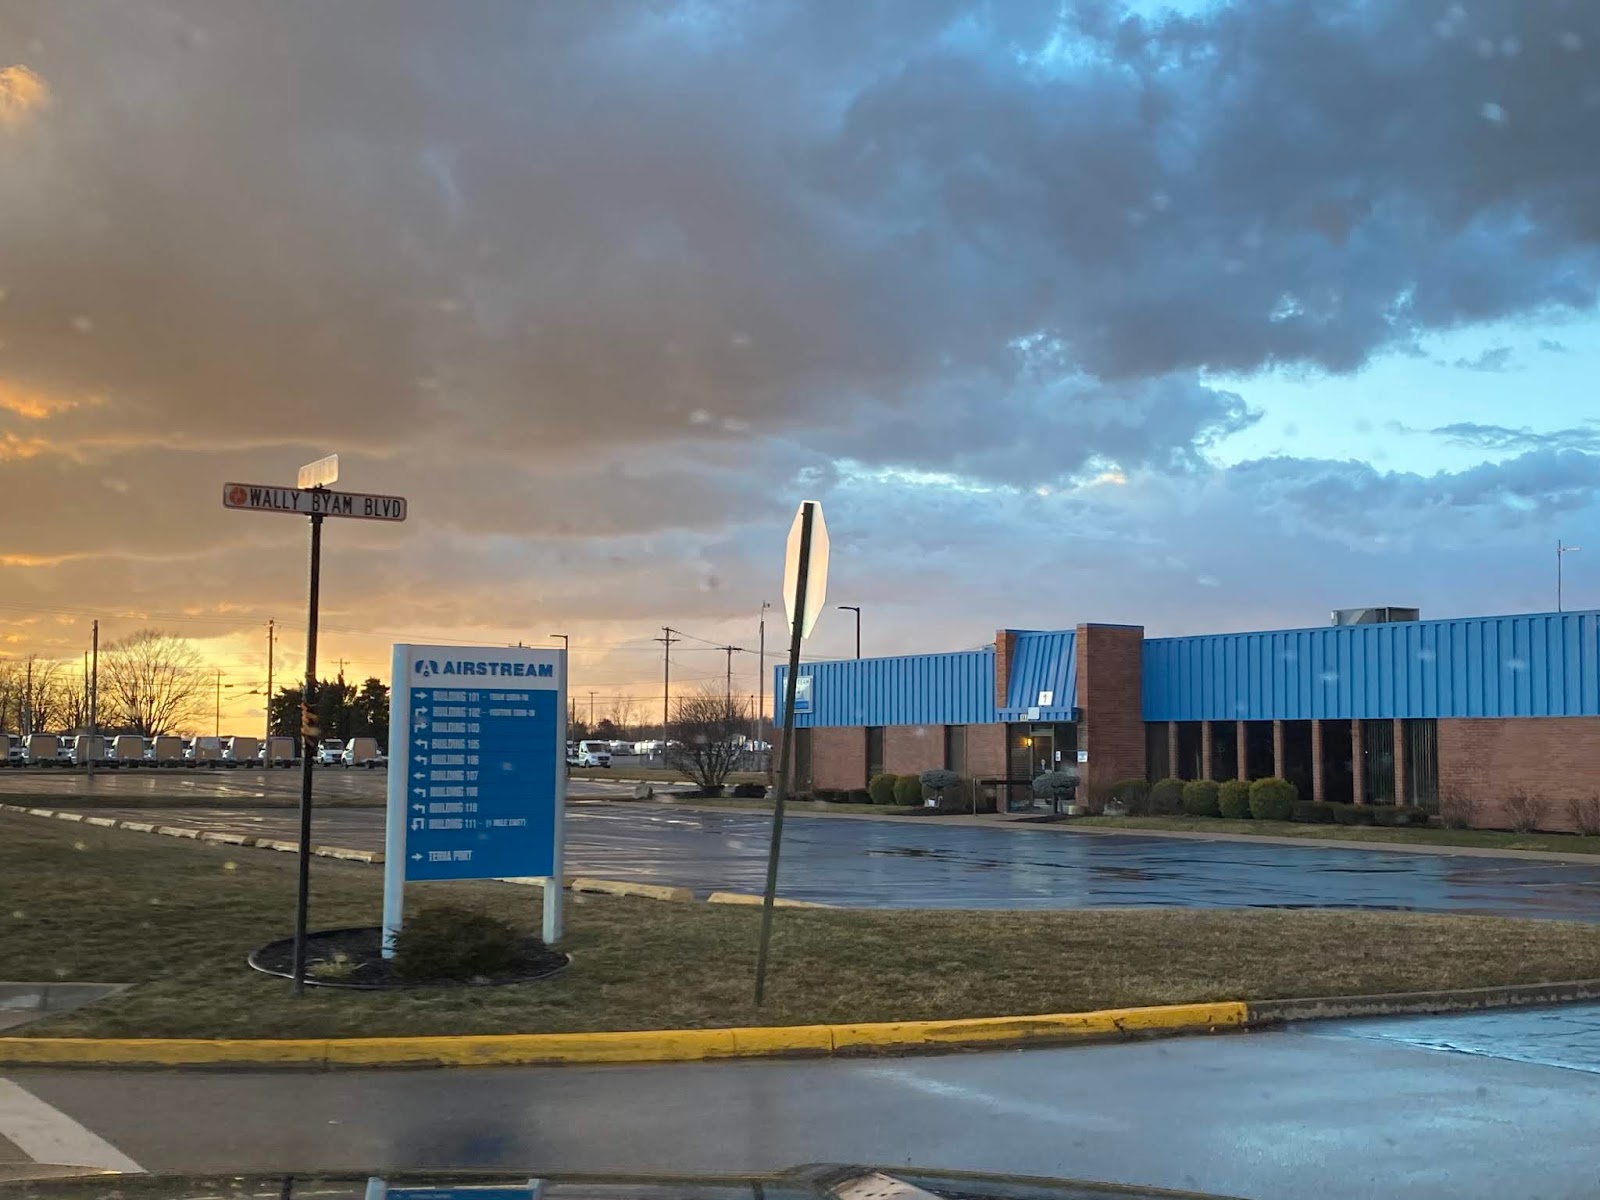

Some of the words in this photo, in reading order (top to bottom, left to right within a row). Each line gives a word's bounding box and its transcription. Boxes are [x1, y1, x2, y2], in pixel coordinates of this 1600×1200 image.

[250, 488, 300, 510] WALLY
[311, 495, 353, 515] BYAM
[364, 498, 401, 518] BLVD
[443, 661, 553, 677] AIRSTREAM
[432, 690, 467, 702] BUILDING
[432, 706, 467, 718] BUILDING
[468, 707, 481, 718] 102
[432, 722, 466, 733] BUILDING
[431, 738, 466, 750] BUILDING
[431, 754, 465, 765] BUILDING
[430, 770, 465, 781] BUILDING
[430, 786, 464, 797] BUILDING
[429, 802, 463, 814] BUILDING
[428, 818, 463, 829] BUILDING
[464, 819, 477, 829] 111
